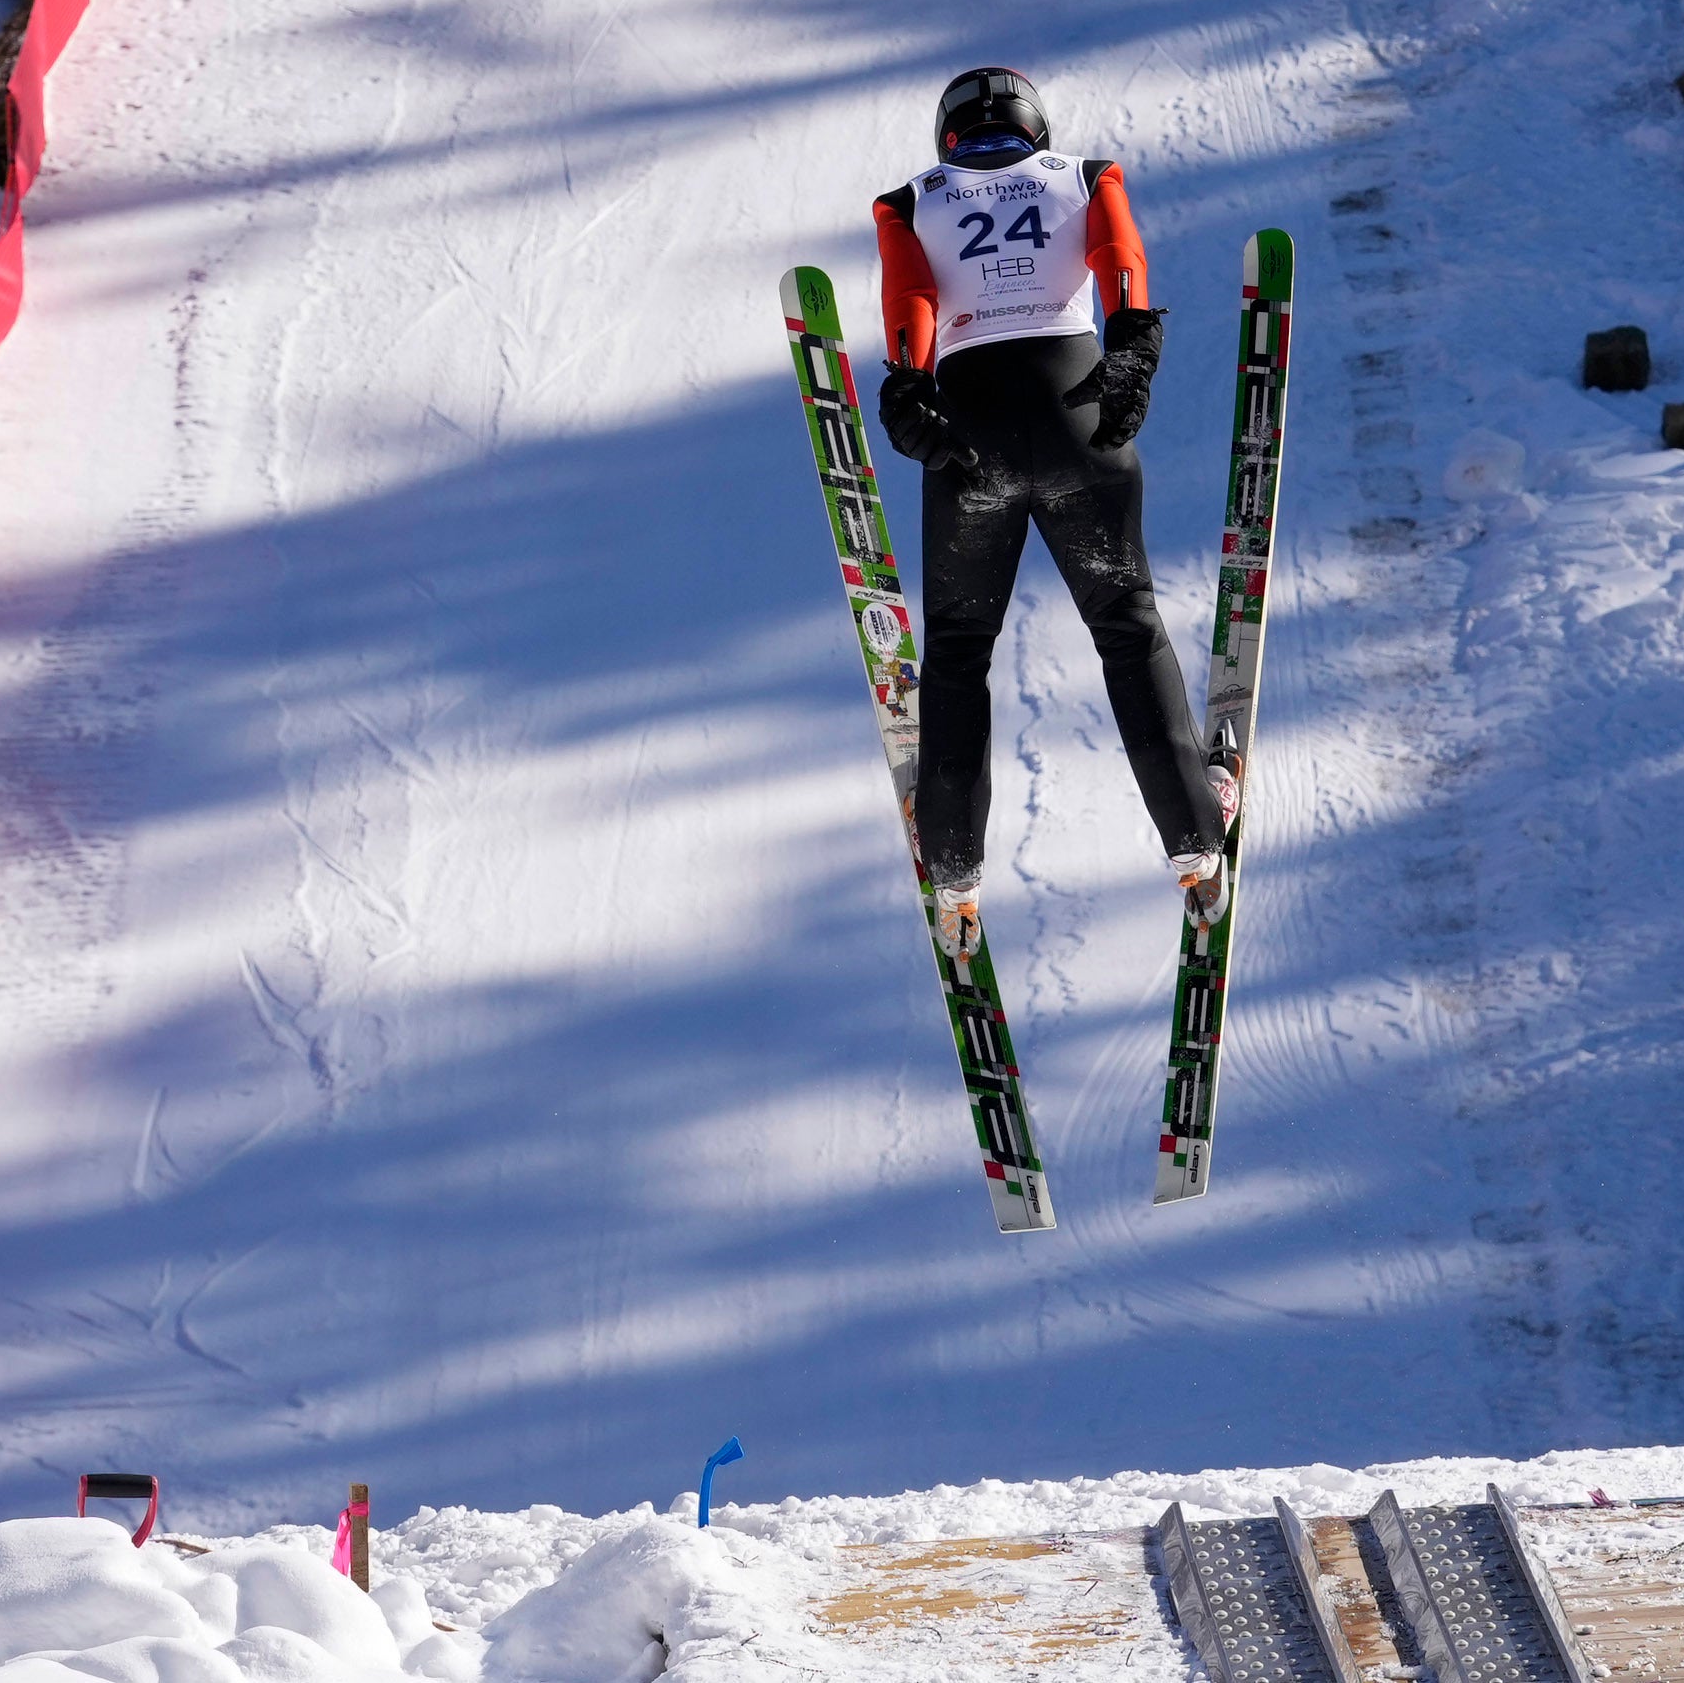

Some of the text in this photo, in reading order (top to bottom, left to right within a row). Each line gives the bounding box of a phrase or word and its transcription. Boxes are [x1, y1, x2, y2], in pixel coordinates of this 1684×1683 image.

[945, 179, 1049, 204] Northway
[999, 191, 1038, 203] BANK
[957, 205, 1051, 261] 24
[981, 256, 1036, 281] HEB
[983, 279, 1037, 295] Engineers
[1190, 1144, 1201, 1184] elan
[1026, 1174, 1041, 1214] elan
